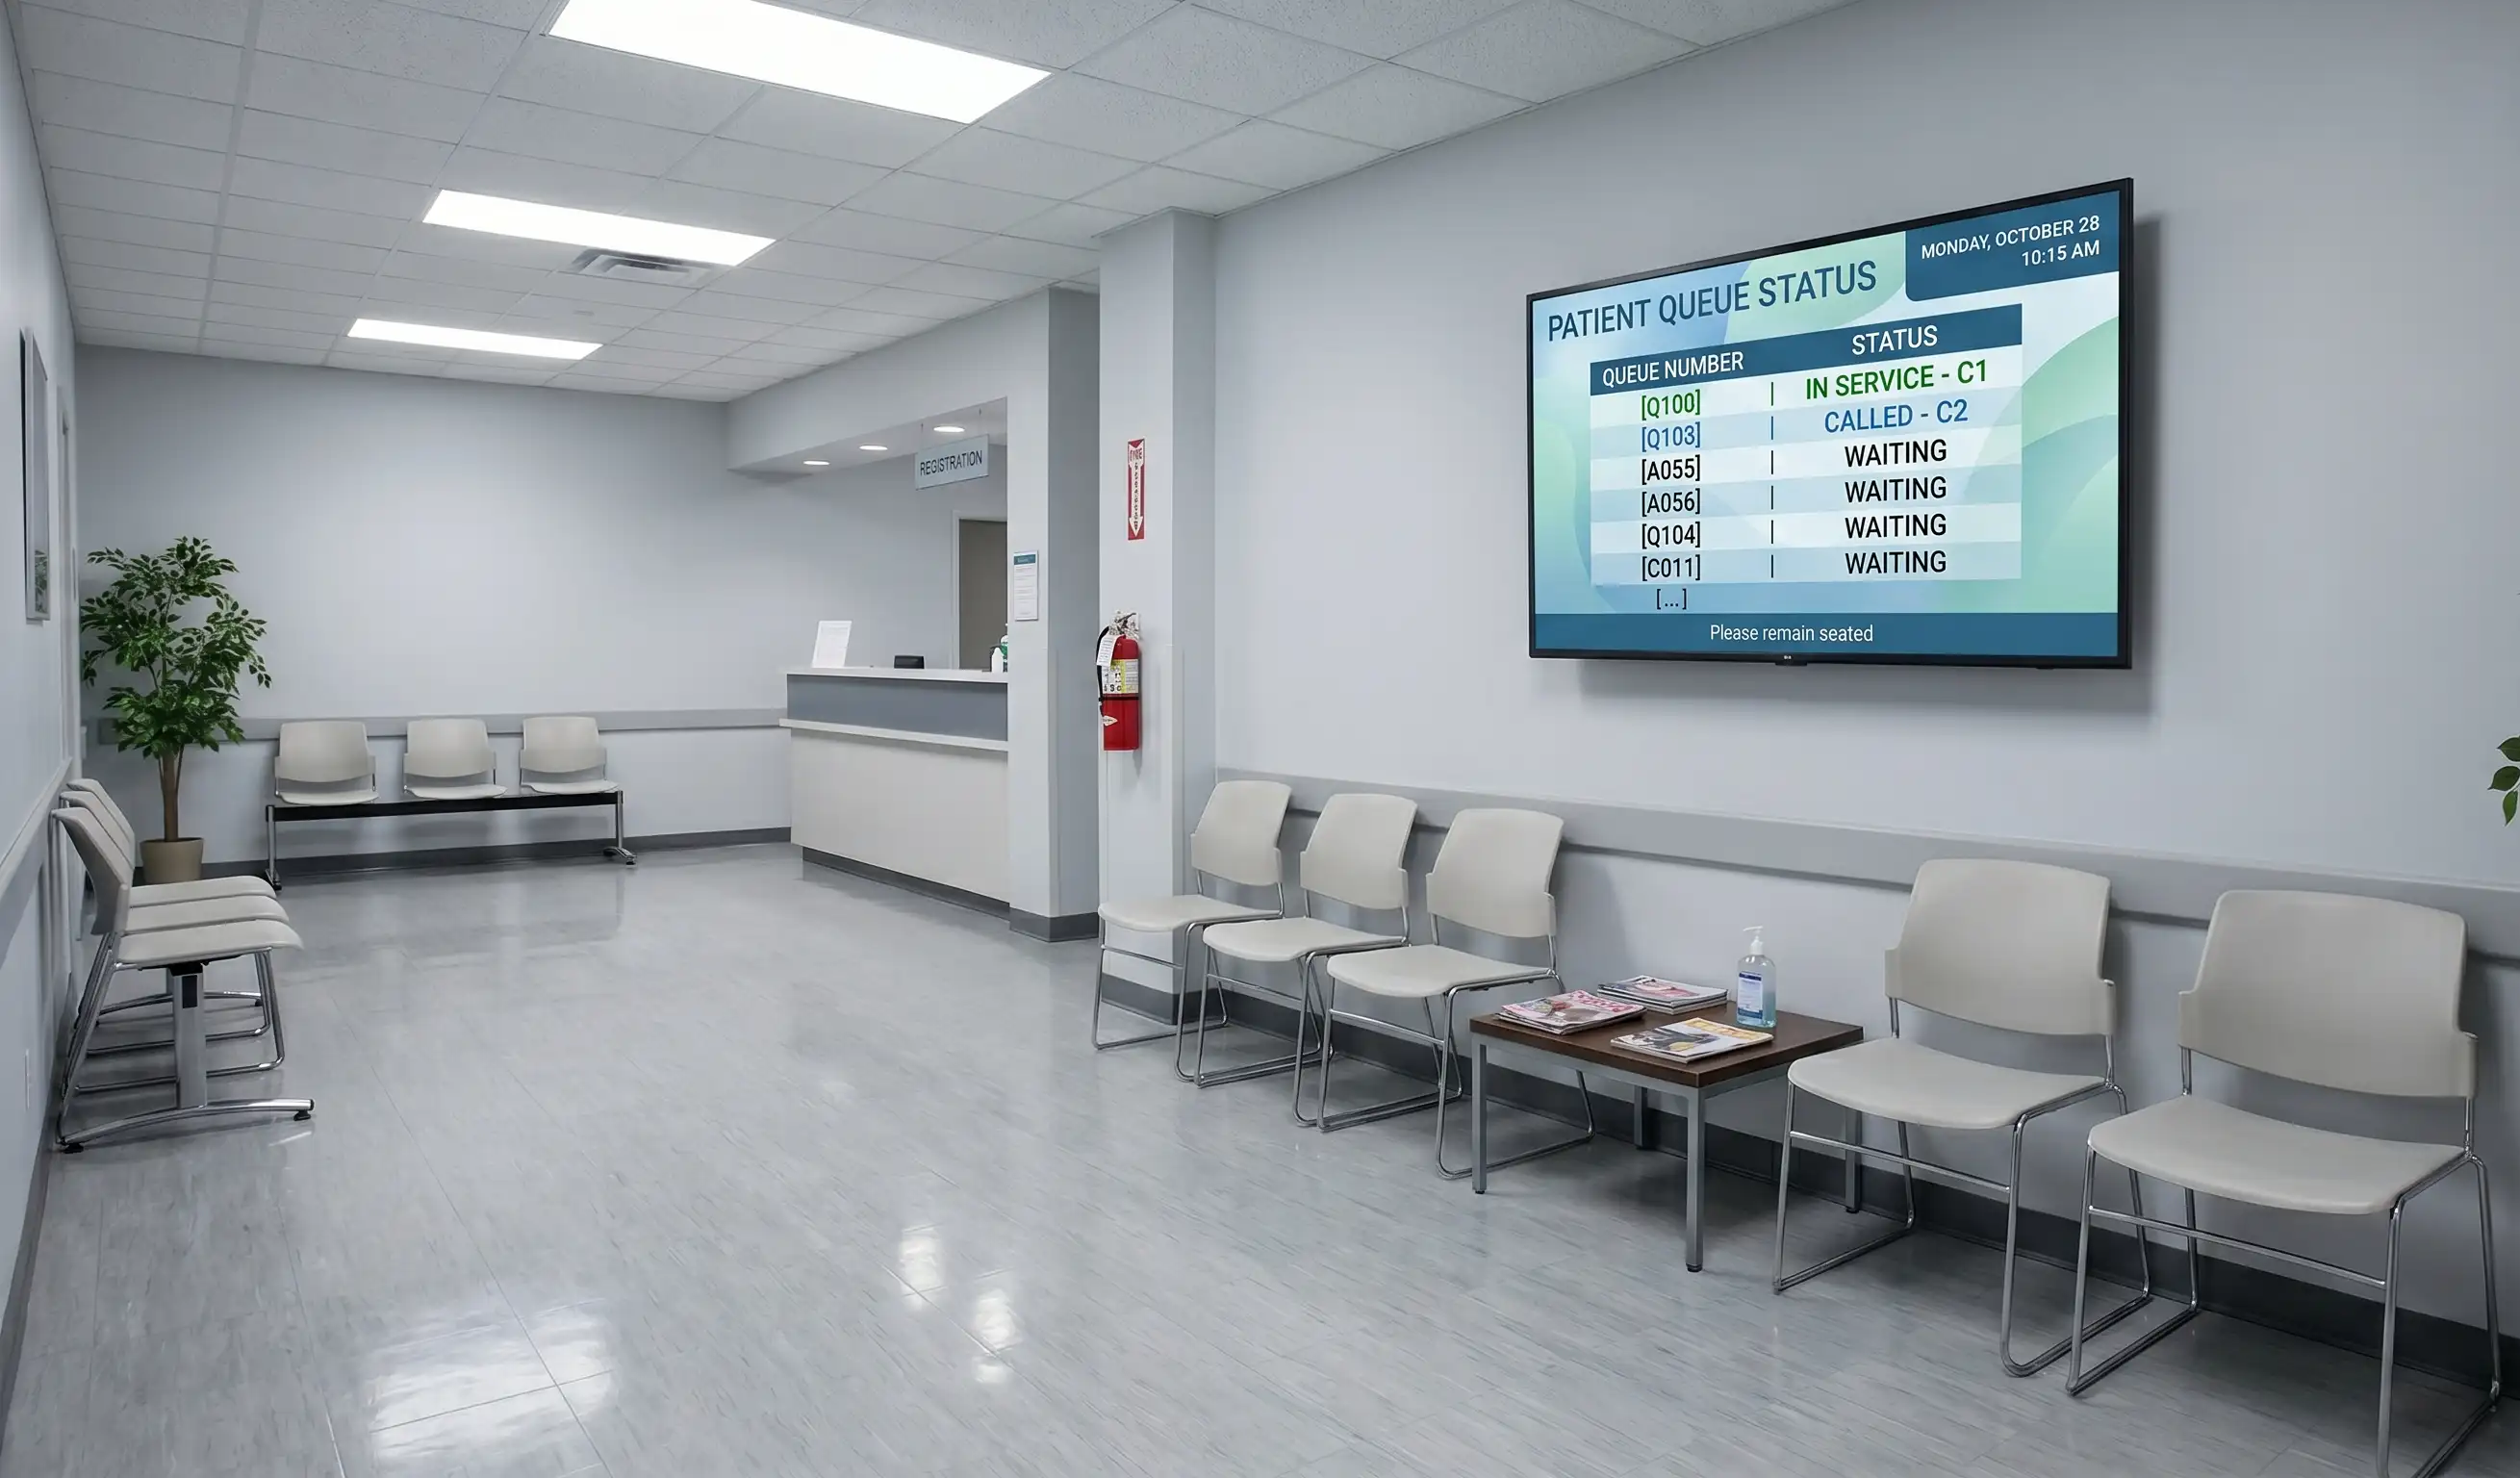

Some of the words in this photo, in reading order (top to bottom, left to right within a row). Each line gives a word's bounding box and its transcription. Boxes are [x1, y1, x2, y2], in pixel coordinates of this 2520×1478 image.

[1922, 234, 1992, 260] MONDAY,
[1995, 219, 2075, 247] OCTOBER
[2078, 215, 2100, 234] 28
[2022, 245, 2067, 267] 10:15
[2071, 240, 2100, 260] AM
[1547, 298, 1652, 342] PATIENT
[1658, 280, 1750, 326] QUEUE
[1758, 260, 1877, 307] STATUS
[1851, 324, 1938, 356] STATUS
[1602, 361, 1660, 389] QUEUE
[1665, 351, 1744, 379] NUMBER
[1806, 376, 1828, 400] IN
[1835, 364, 1934, 397] SERVICE
[1957, 359, 1986, 384] C1
[1642, 389, 1701, 421] [Q100]
[1824, 404, 1913, 433] CALLED
[1936, 398, 1969, 423] C2
[1642, 421, 1701, 453] [Q103]
[920, 449, 982, 477] REGISTRATION
[1844, 438, 1947, 468] WAITING
[1642, 454, 1701, 486] [A055]
[1642, 488, 1701, 518] [A056]
[1844, 475, 1947, 503] WAITING
[1642, 521, 1701, 550] [Q104]
[1844, 513, 1947, 539] WAITING
[1642, 553, 1701, 582] [C011]
[1845, 549, 1947, 574] WAITING
[1710, 624, 1759, 641] Please
[1763, 624, 1815, 642] remain
[1819, 624, 1874, 643] seated
